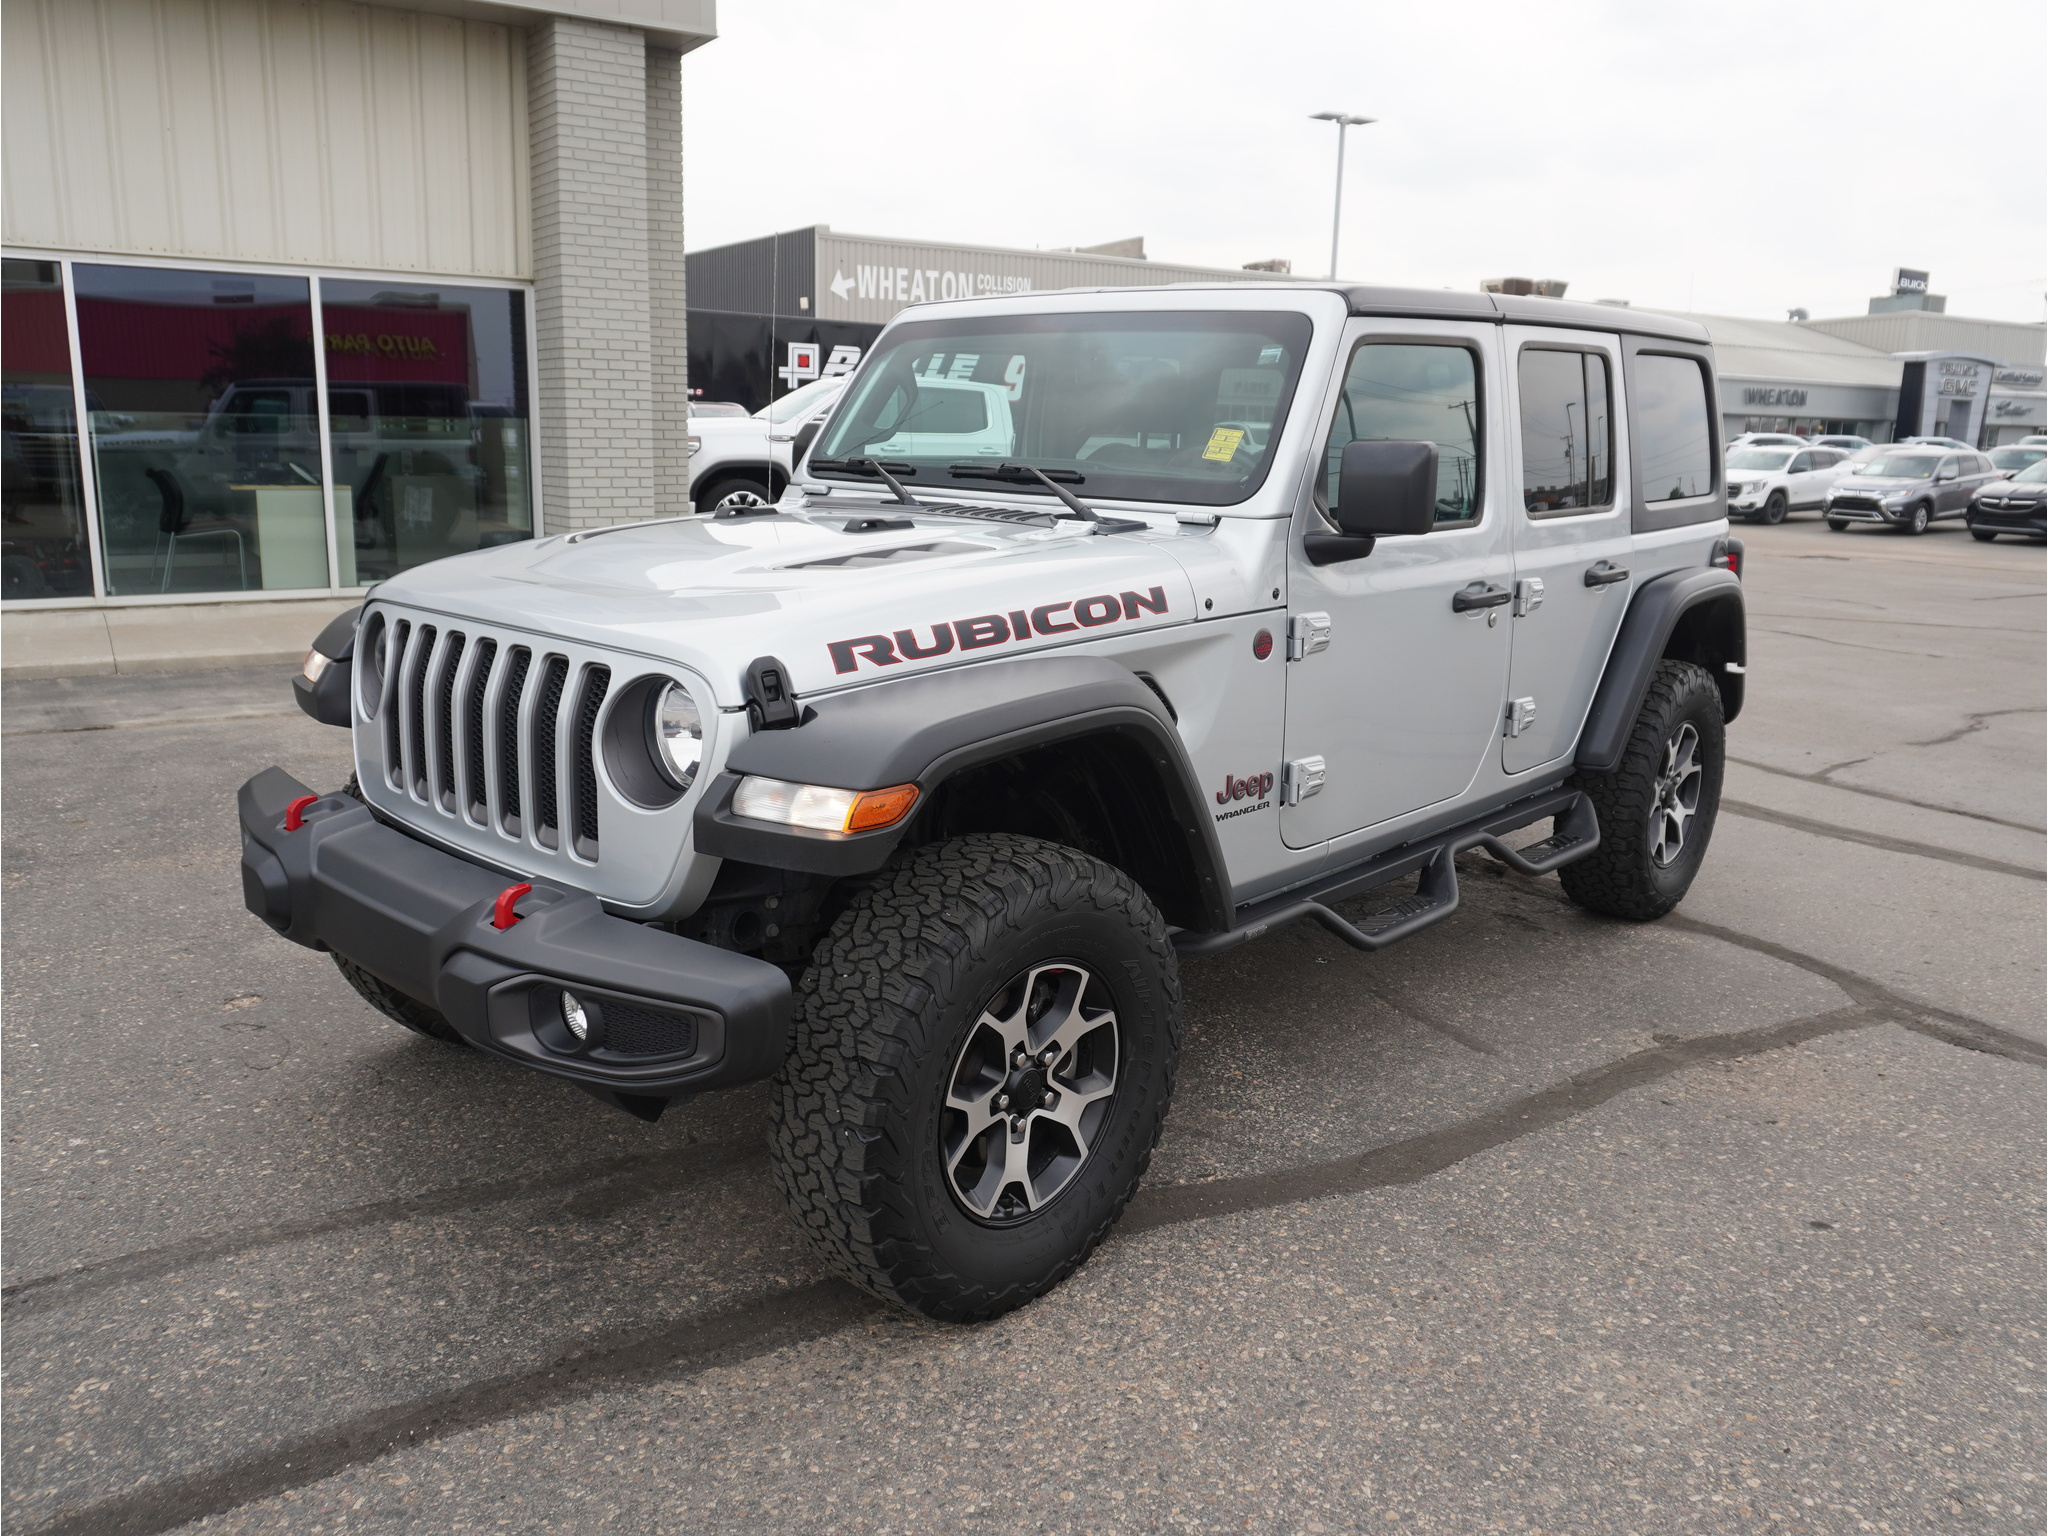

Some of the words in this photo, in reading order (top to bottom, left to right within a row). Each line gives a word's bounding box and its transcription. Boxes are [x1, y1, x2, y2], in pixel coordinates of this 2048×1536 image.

[857, 264, 974, 302] WHEATON
[977, 273, 1031, 292] COLLISION
[1900, 277, 1928, 290] BUICK
[1743, 387, 1809, 407] WHEATON
[1942, 378, 1979, 396] GMC
[827, 585, 1169, 675] RUBICON
[1216, 771, 1274, 805] Jeep
[1215, 801, 1270, 823] WRANGLER
